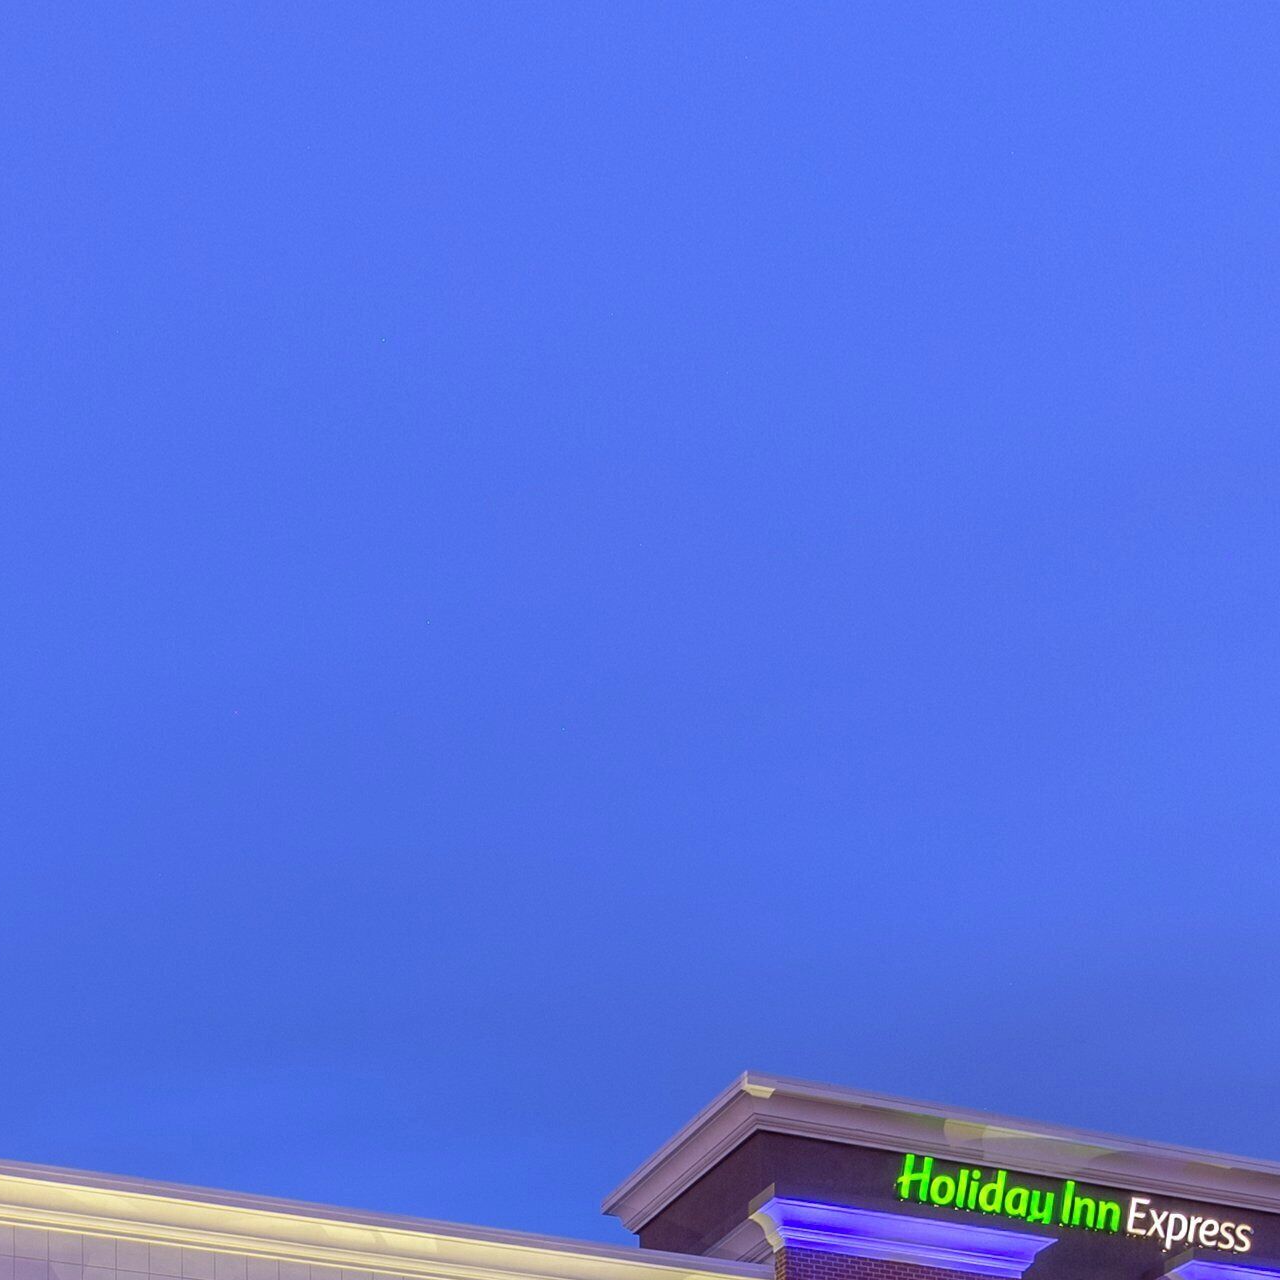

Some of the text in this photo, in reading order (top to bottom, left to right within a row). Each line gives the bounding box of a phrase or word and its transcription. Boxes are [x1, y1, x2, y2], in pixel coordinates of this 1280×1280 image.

[897, 1153, 1252, 1252] Holiday Inn Express
